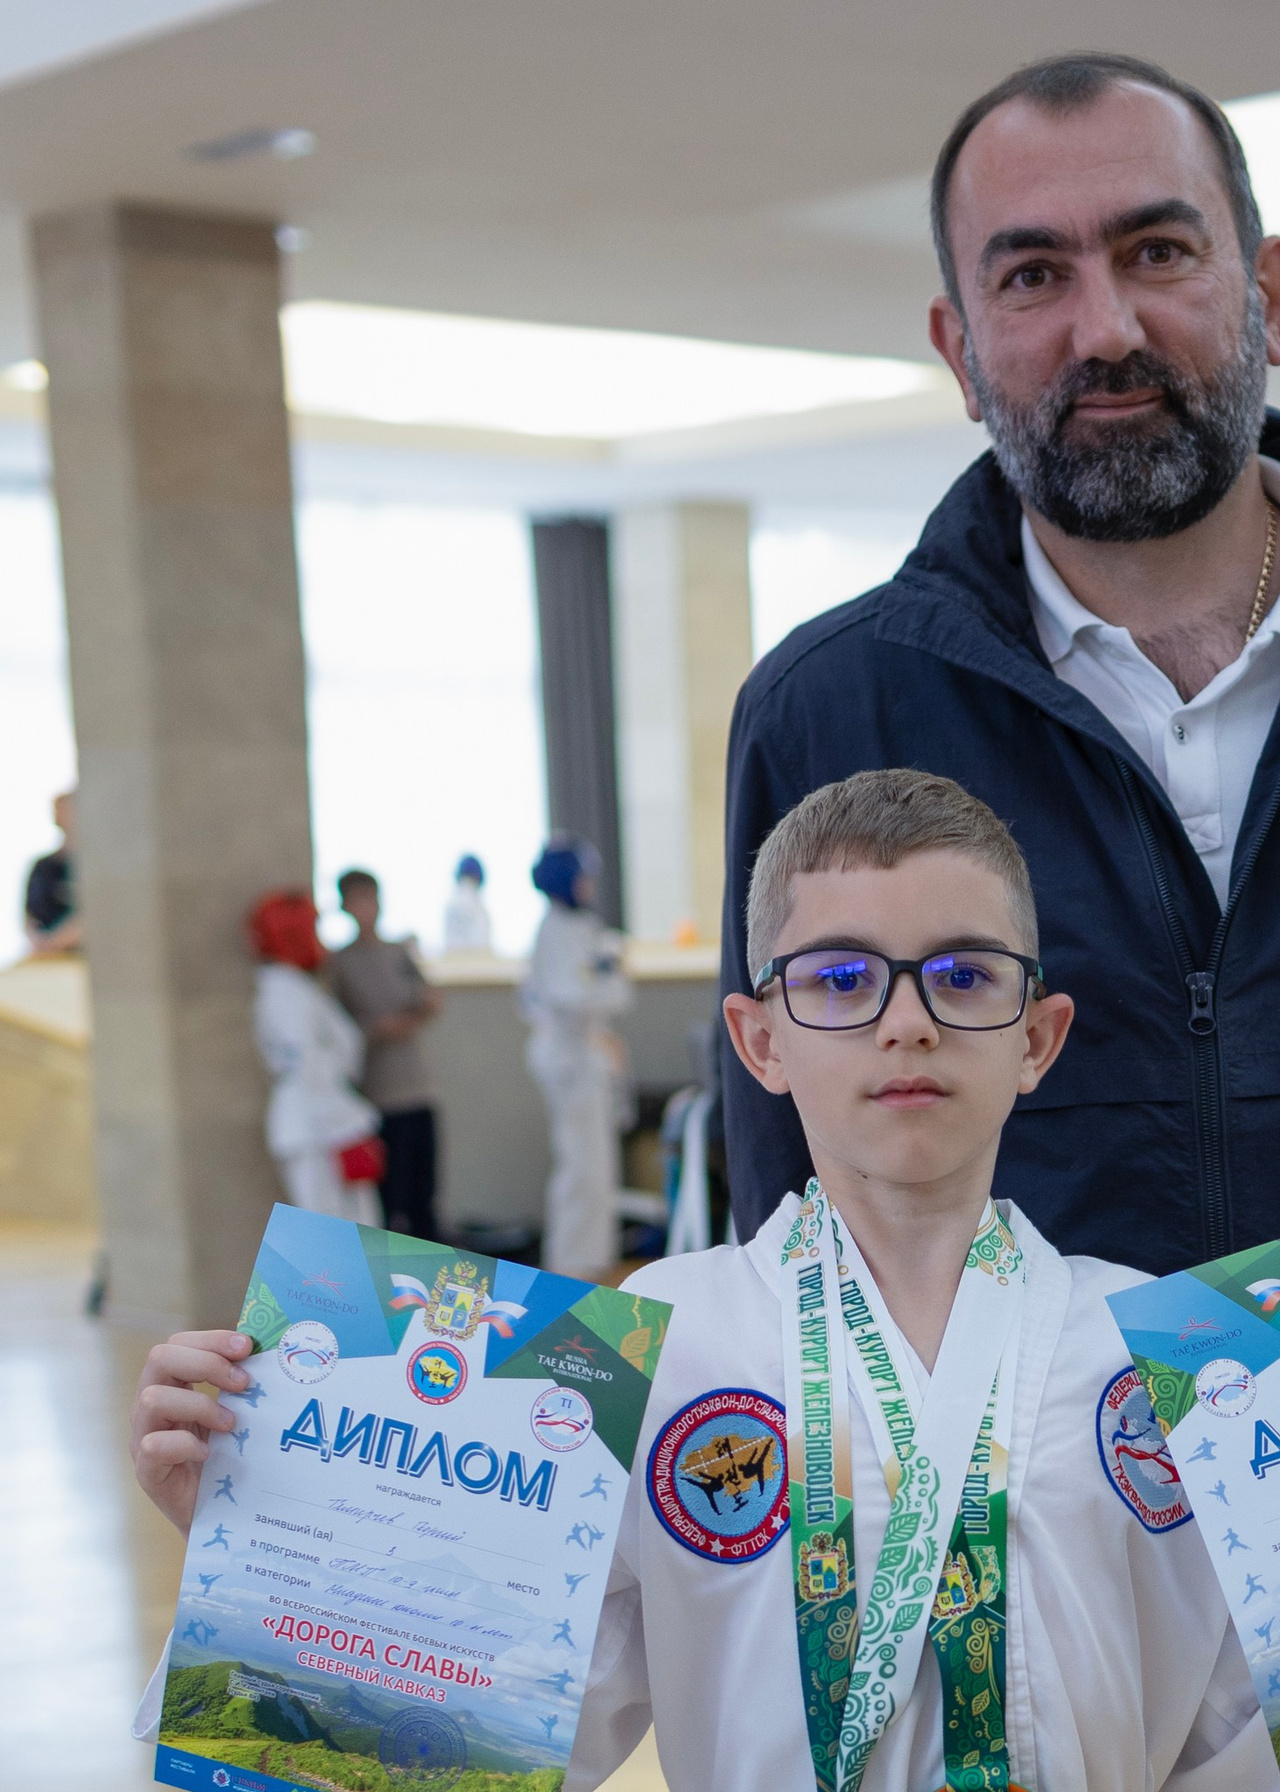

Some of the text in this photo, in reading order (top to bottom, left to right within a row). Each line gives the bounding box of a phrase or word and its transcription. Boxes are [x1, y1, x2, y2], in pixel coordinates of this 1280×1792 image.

[564, 1353, 588, 1366] RUSSIA
[839, 1278, 903, 1393] ГОРОД-КУРОРТ
[797, 1262, 836, 1525] ГОРОД-КУРОРТ ЖЕЛЕЗНОВОДСК
[280, 1398, 559, 1512] ДИПЛОМ
[656, 1413, 696, 1498] ТРАДИЦИОННОГО
[374, 1481, 442, 1509] награждается
[253, 1510, 334, 1543] занявший (ая)
[257, 1540, 320, 1567] программе
[252, 1565, 311, 1590] категории
[505, 1578, 541, 1597] место
[262, 1614, 493, 1689] «ДОРОГА СЛАВЫ»
[268, 1594, 496, 1663] ВО ВСЕРОССИЙСКОМ ФЕСТИВАЛЕ БОЕВЫХ ИСКУССТВ
[296, 1645, 447, 1704] СЕВЕРНЫЙ КАВКАЗ
